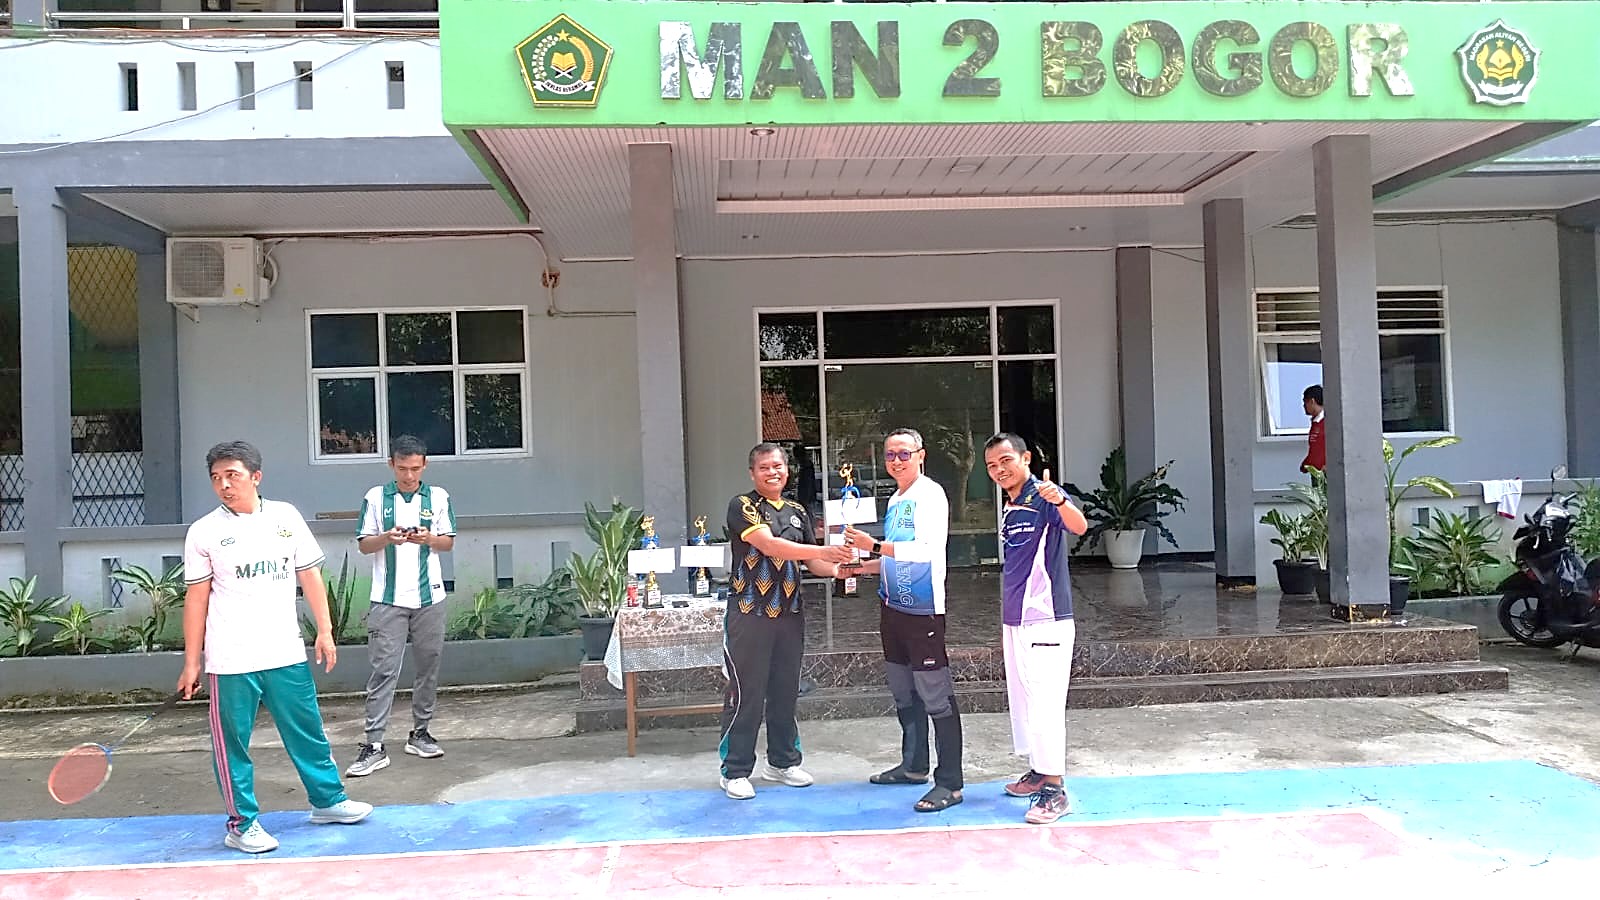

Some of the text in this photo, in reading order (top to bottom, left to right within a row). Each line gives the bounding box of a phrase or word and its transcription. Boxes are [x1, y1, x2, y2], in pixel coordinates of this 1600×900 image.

[658, 19, 1415, 100] MAN 2 BOGOR
[235, 560, 277, 579] MAN
[896, 561, 914, 606] ENAG
